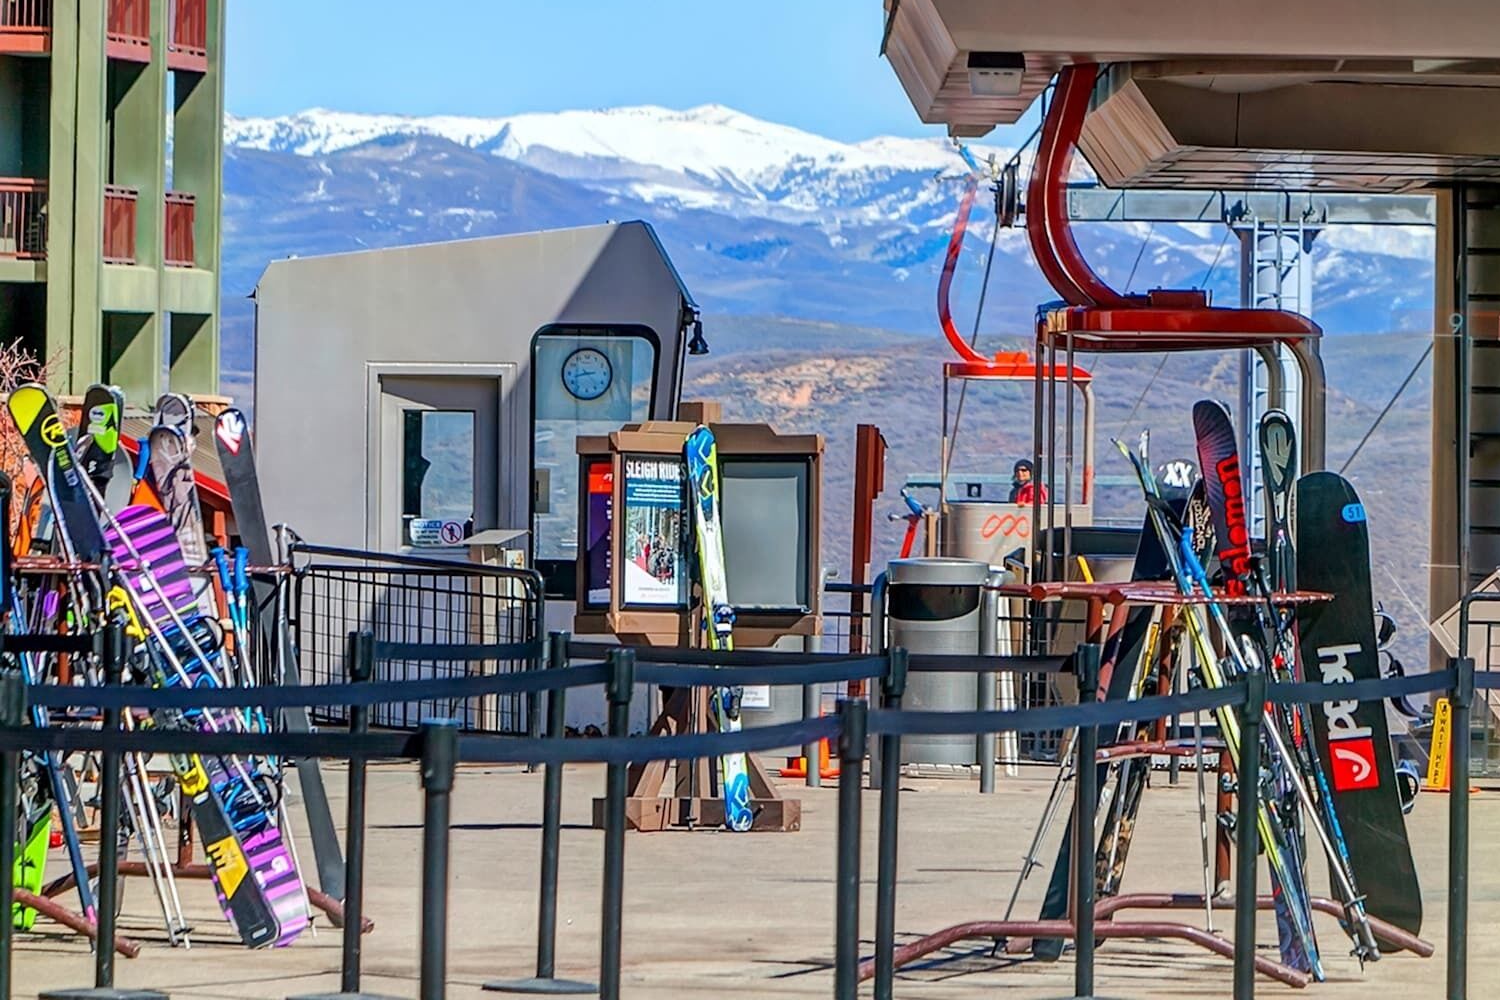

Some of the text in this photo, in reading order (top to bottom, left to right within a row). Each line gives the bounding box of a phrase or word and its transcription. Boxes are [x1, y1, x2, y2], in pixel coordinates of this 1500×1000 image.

[626, 461, 687, 481] SLEIGH RIDES
[1438, 719, 1446, 748] WAIT
